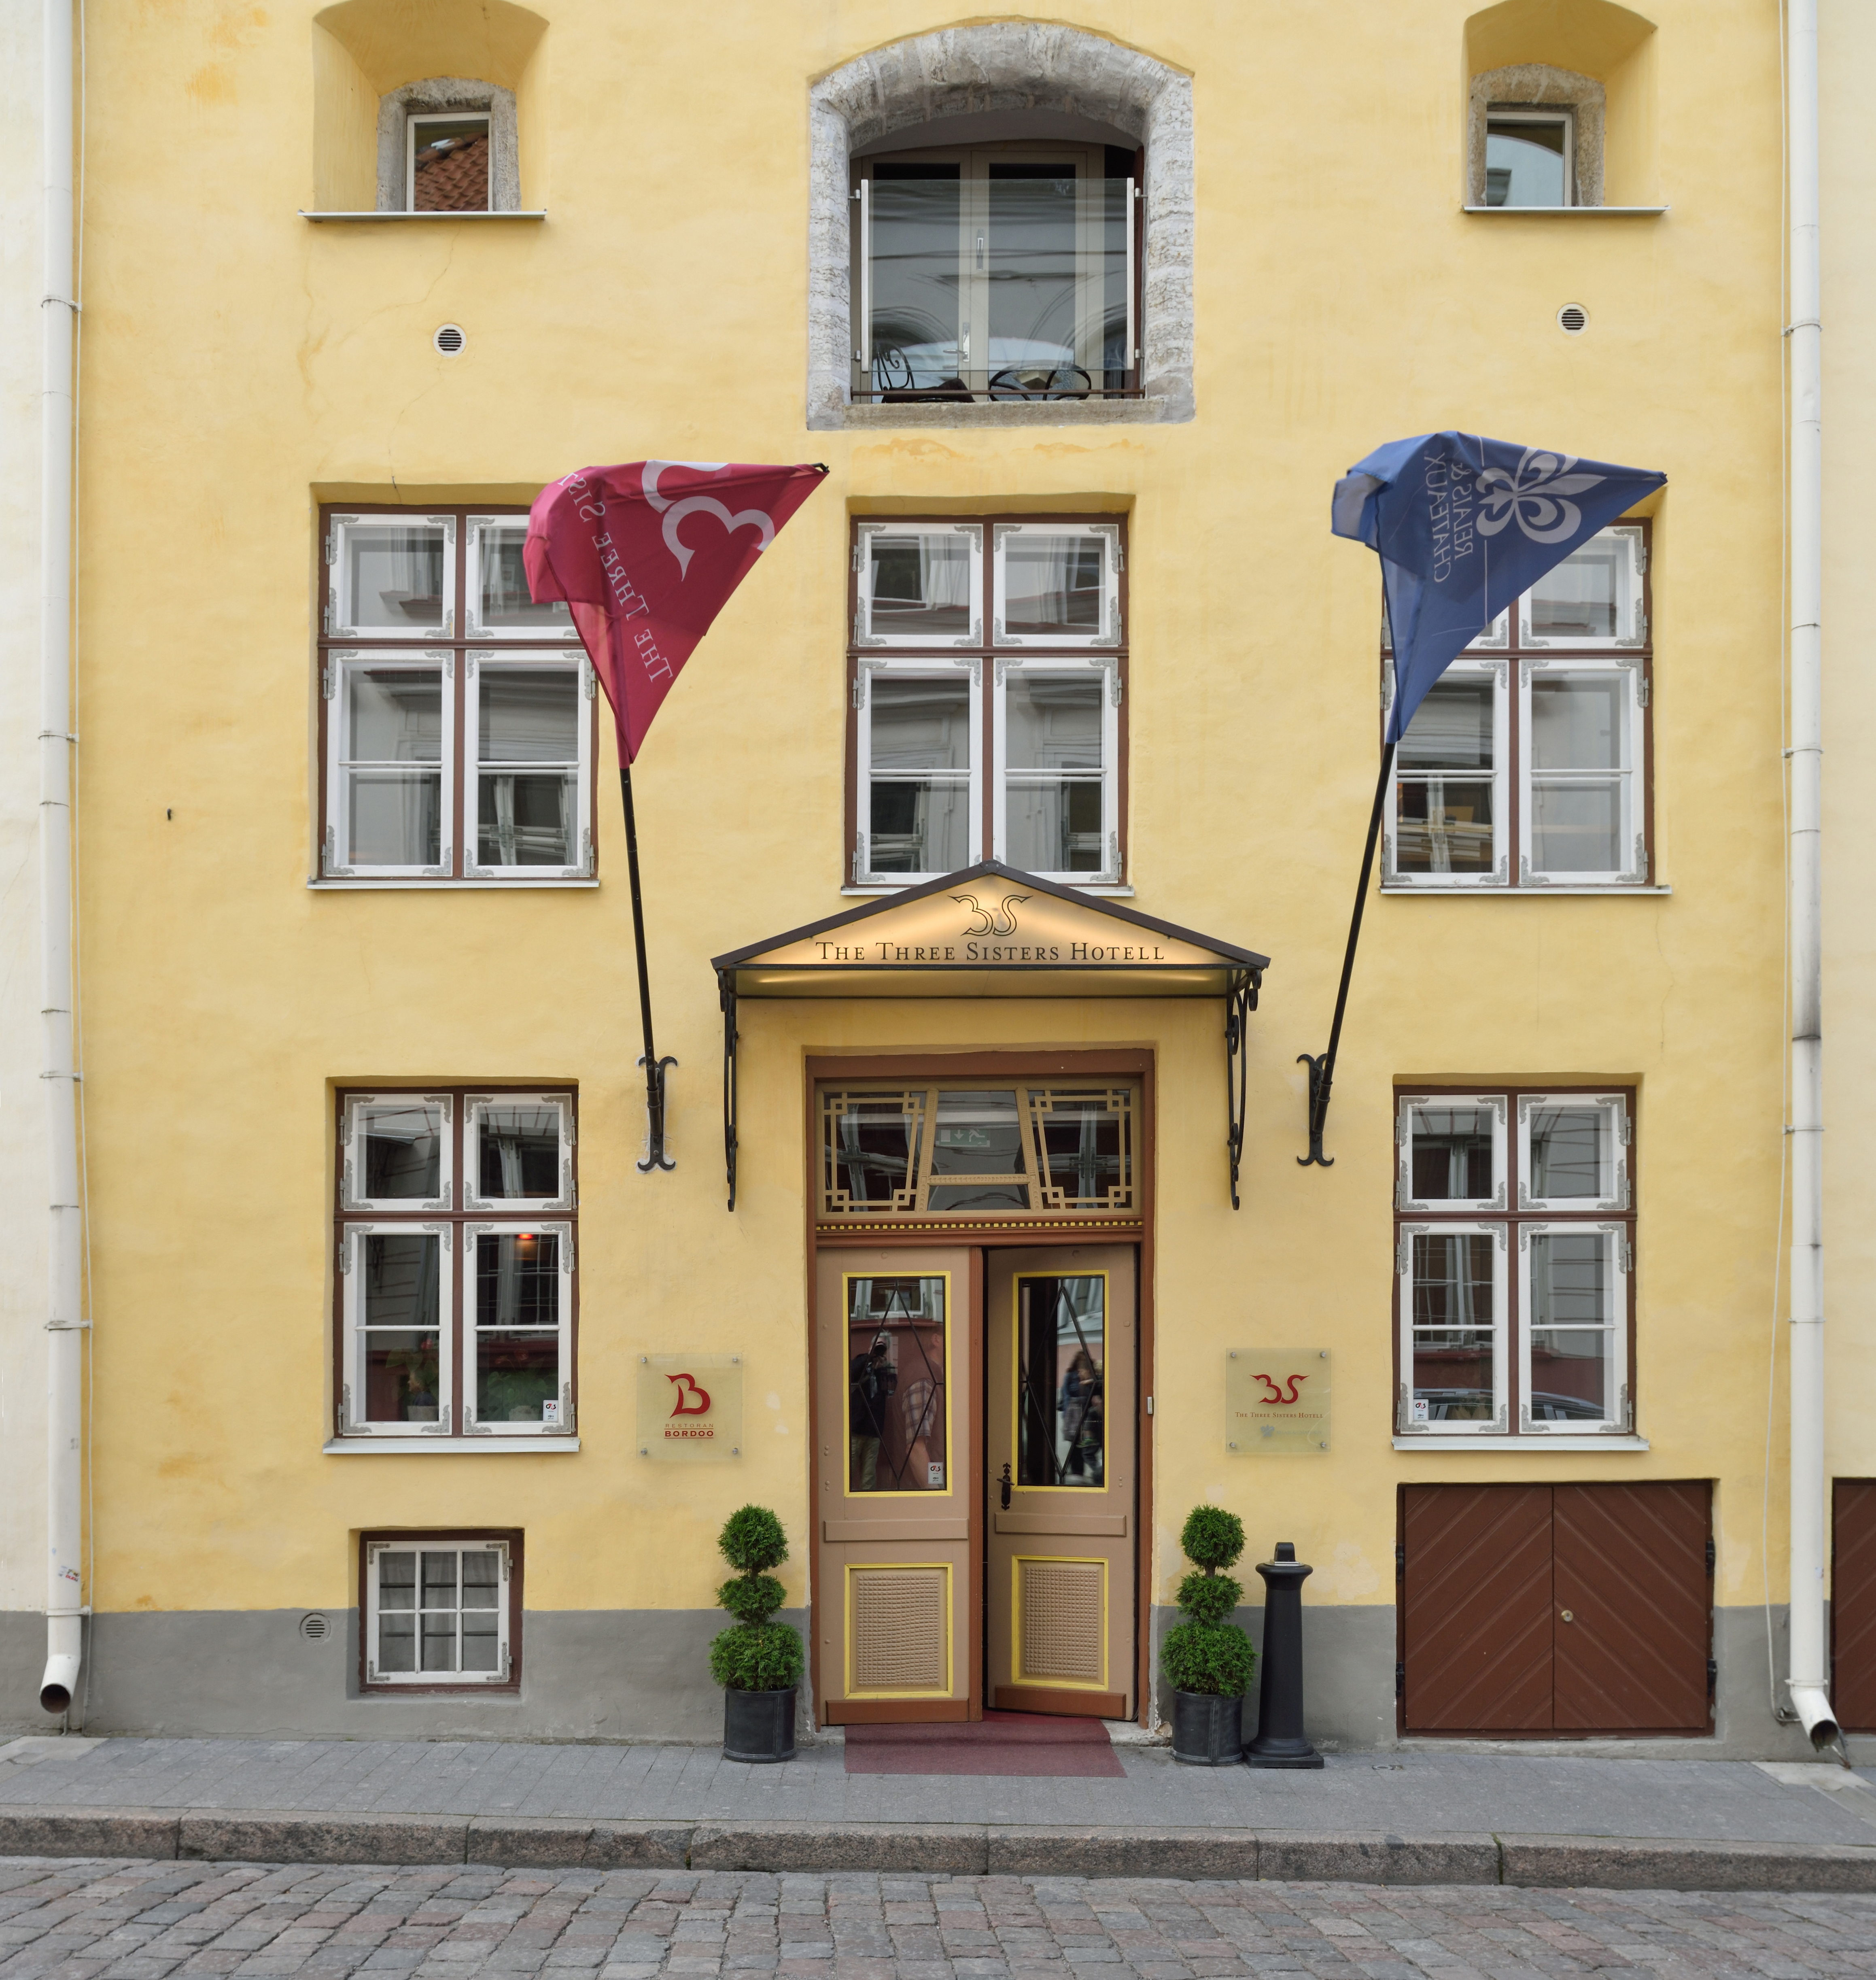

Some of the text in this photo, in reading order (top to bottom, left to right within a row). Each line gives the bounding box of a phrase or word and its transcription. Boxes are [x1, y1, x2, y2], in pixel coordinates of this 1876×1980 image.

[815, 941, 1165, 961] THE THREE SISTERS HOTELL
